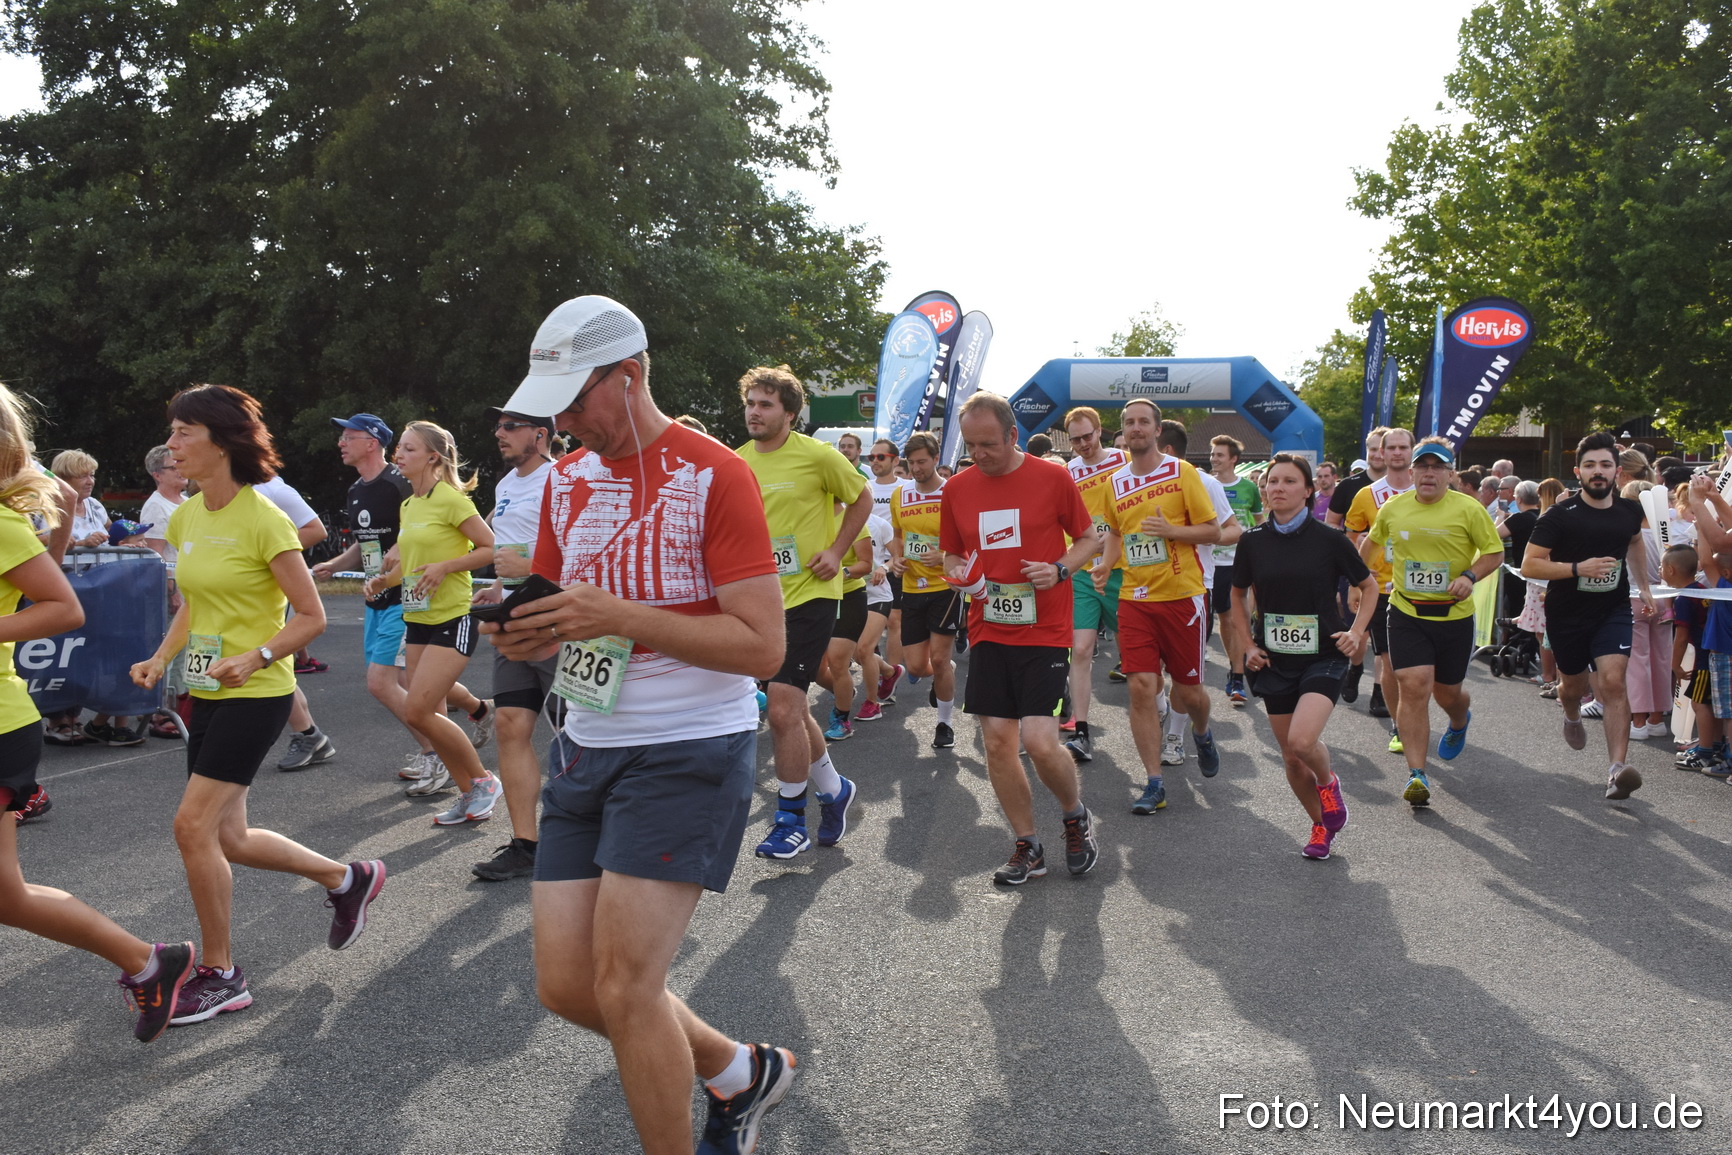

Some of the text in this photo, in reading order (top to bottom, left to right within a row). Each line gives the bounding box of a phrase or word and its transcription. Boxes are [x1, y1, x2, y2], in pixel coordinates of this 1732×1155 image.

[1460, 316, 1522, 339] Hervis
[958, 324, 982, 386] Fischer
[969, 332, 984, 377] AUTOMOBILE
[1131, 382, 1191, 394] firmenlauf
[1016, 398, 1051, 410] Fischer
[1116, 483, 1182, 514] MAX BÖGL
[900, 508, 922, 518] MAX
[1129, 542, 1159, 558] 1711
[1409, 572, 1443, 585] 1219
[992, 598, 1022, 613] 469
[1271, 627, 1311, 643] 1864
[561, 644, 613, 687] 2236
